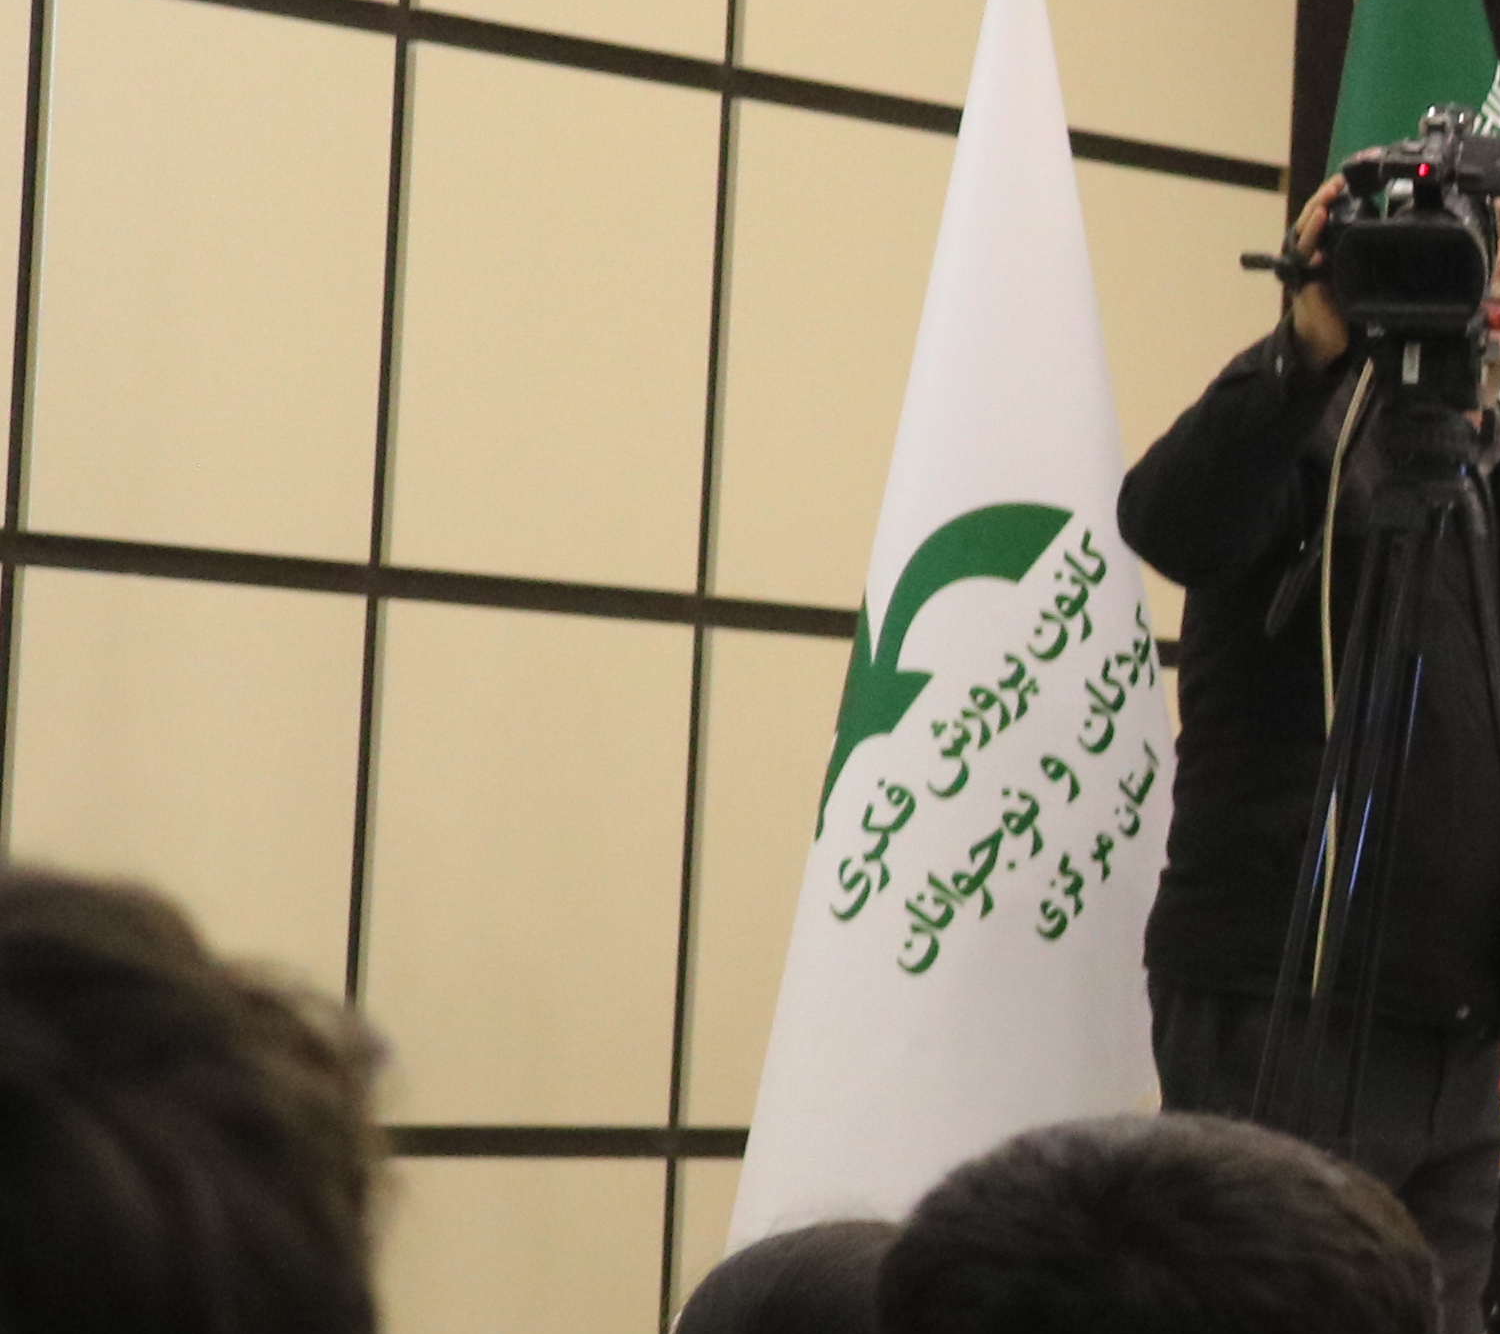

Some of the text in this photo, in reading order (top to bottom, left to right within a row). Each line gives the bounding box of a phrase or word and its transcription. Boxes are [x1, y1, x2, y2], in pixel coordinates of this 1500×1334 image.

[829, 528, 1107, 922] کانون پرورش فکری
[897, 600, 1157, 975] کودکان و نوجوانان
[1035, 737, 1161, 943] استان مرکزی
